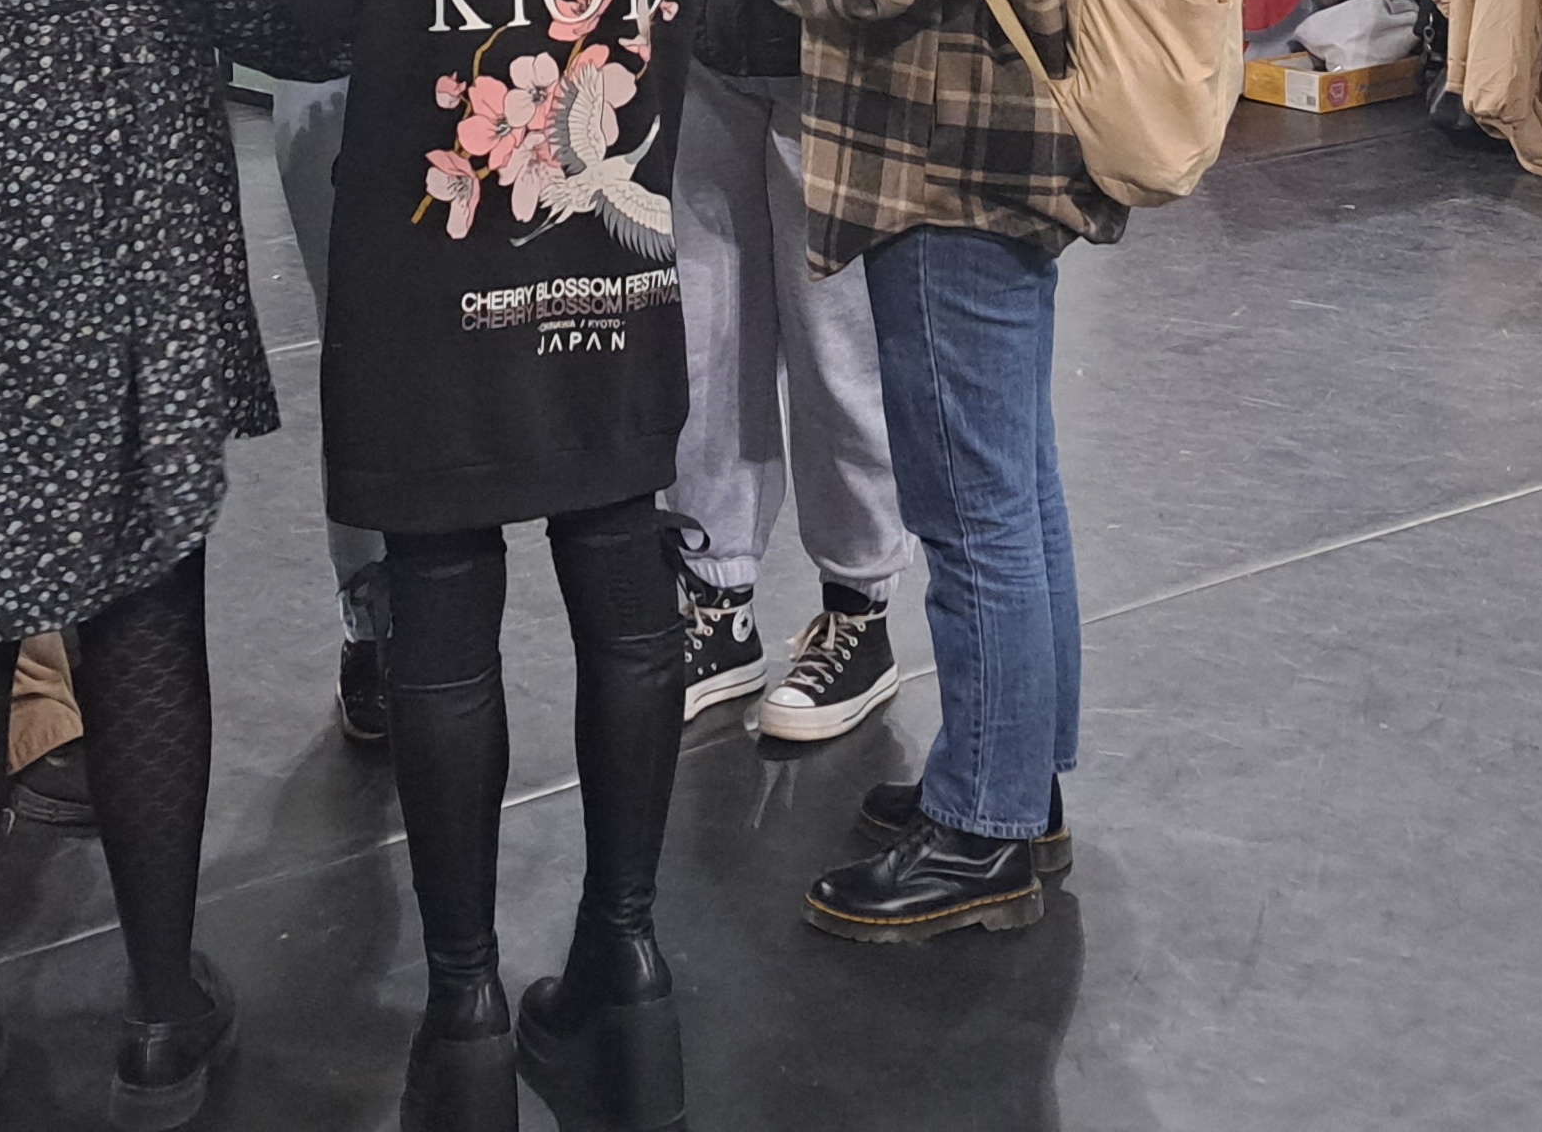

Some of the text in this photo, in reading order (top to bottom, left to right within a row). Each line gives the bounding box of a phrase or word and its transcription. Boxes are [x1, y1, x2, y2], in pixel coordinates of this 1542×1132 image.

[461, 266, 678, 312] CHERRY BLOSSOM FESTIVA
[626, 286, 680, 312] FESTIVA
[537, 330, 625, 355] JAPAN
